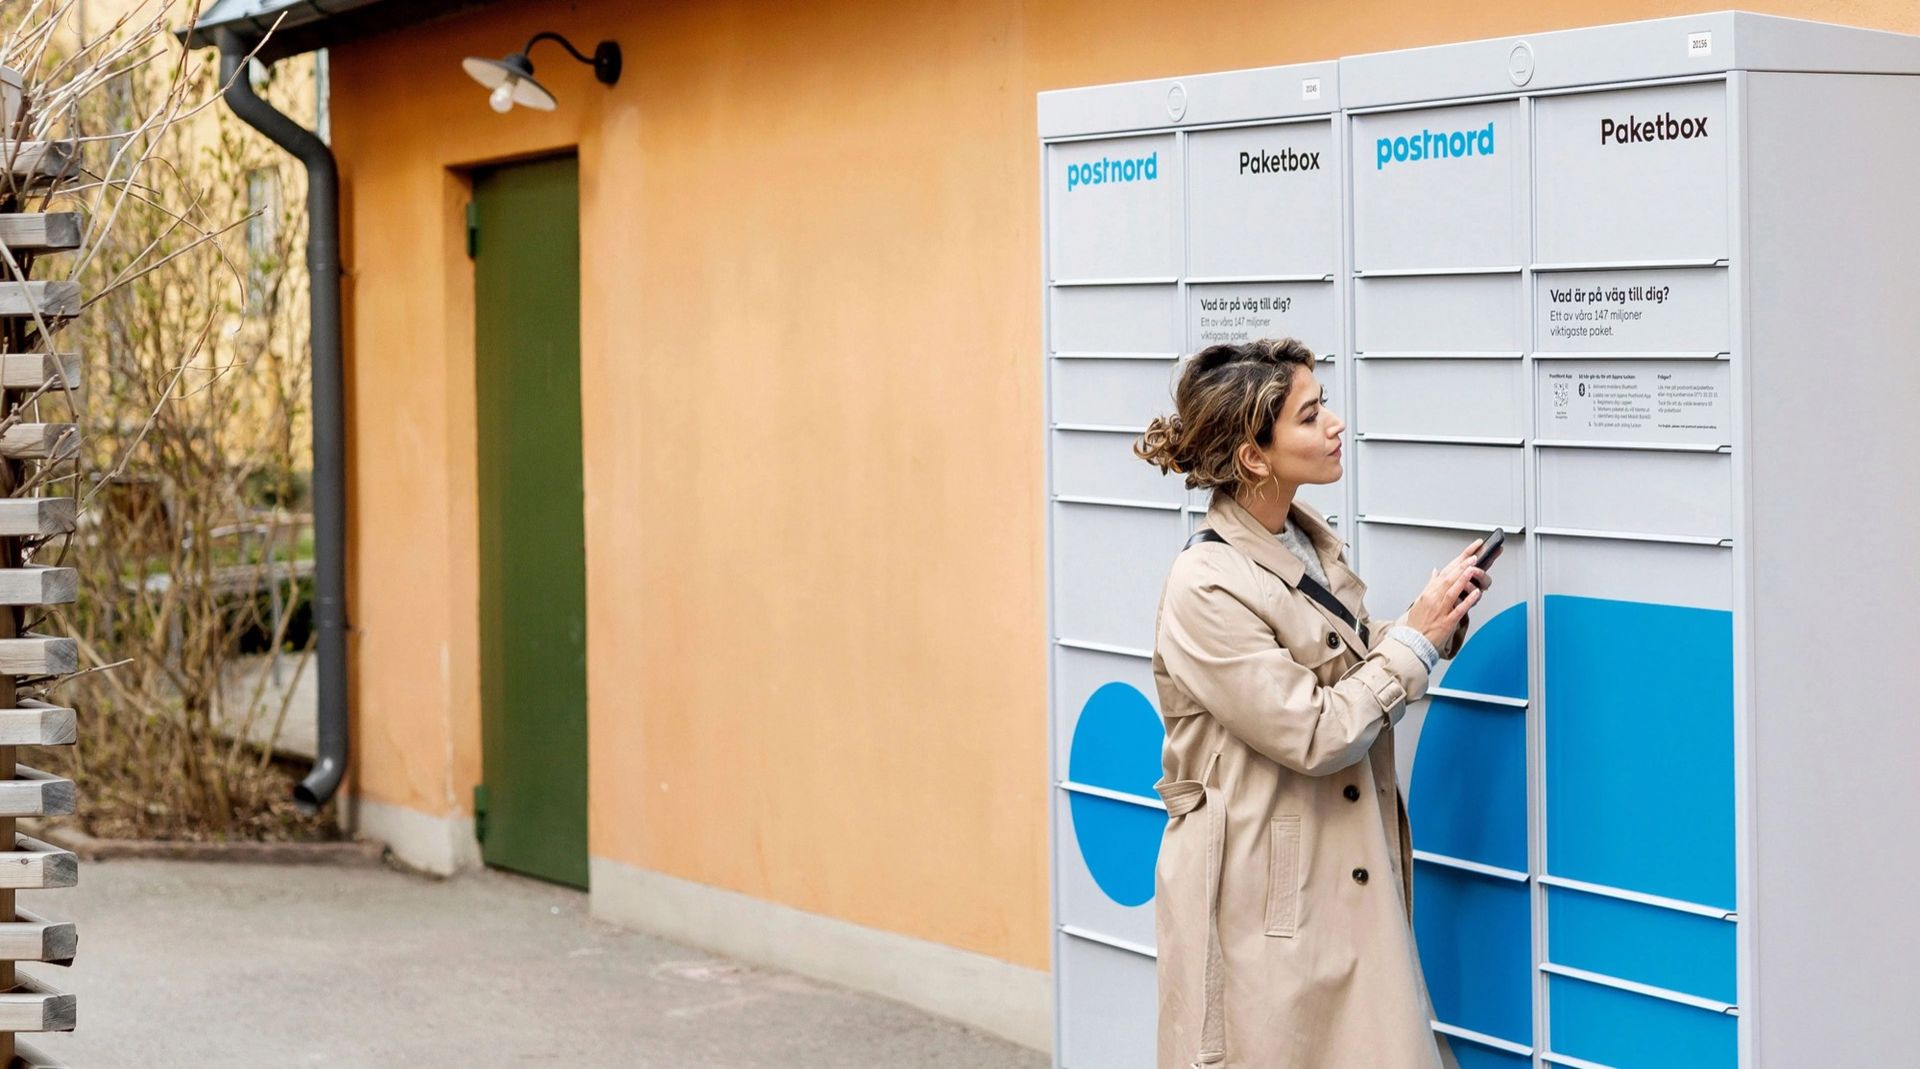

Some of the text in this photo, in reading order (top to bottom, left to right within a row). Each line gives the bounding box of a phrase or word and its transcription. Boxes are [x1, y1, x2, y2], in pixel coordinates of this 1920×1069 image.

[1600, 112, 1708, 146] Paketbox
[1376, 121, 1495, 171] postnord
[1240, 147, 1321, 176] Paketbox
[1067, 151, 1158, 192] postnord
[1550, 286, 1670, 305] Vad är på väg till dig?
[1200, 297, 1292, 313] Vad är på väg till dig?
[1200, 317, 1271, 328] Ett av våra 147 miljoner
[1550, 309, 1642, 322] Ett av våra 147 miljoner
[1200, 332, 1249, 342] viktigaste paket.
[1550, 326, 1614, 339] viktigaste paket.
